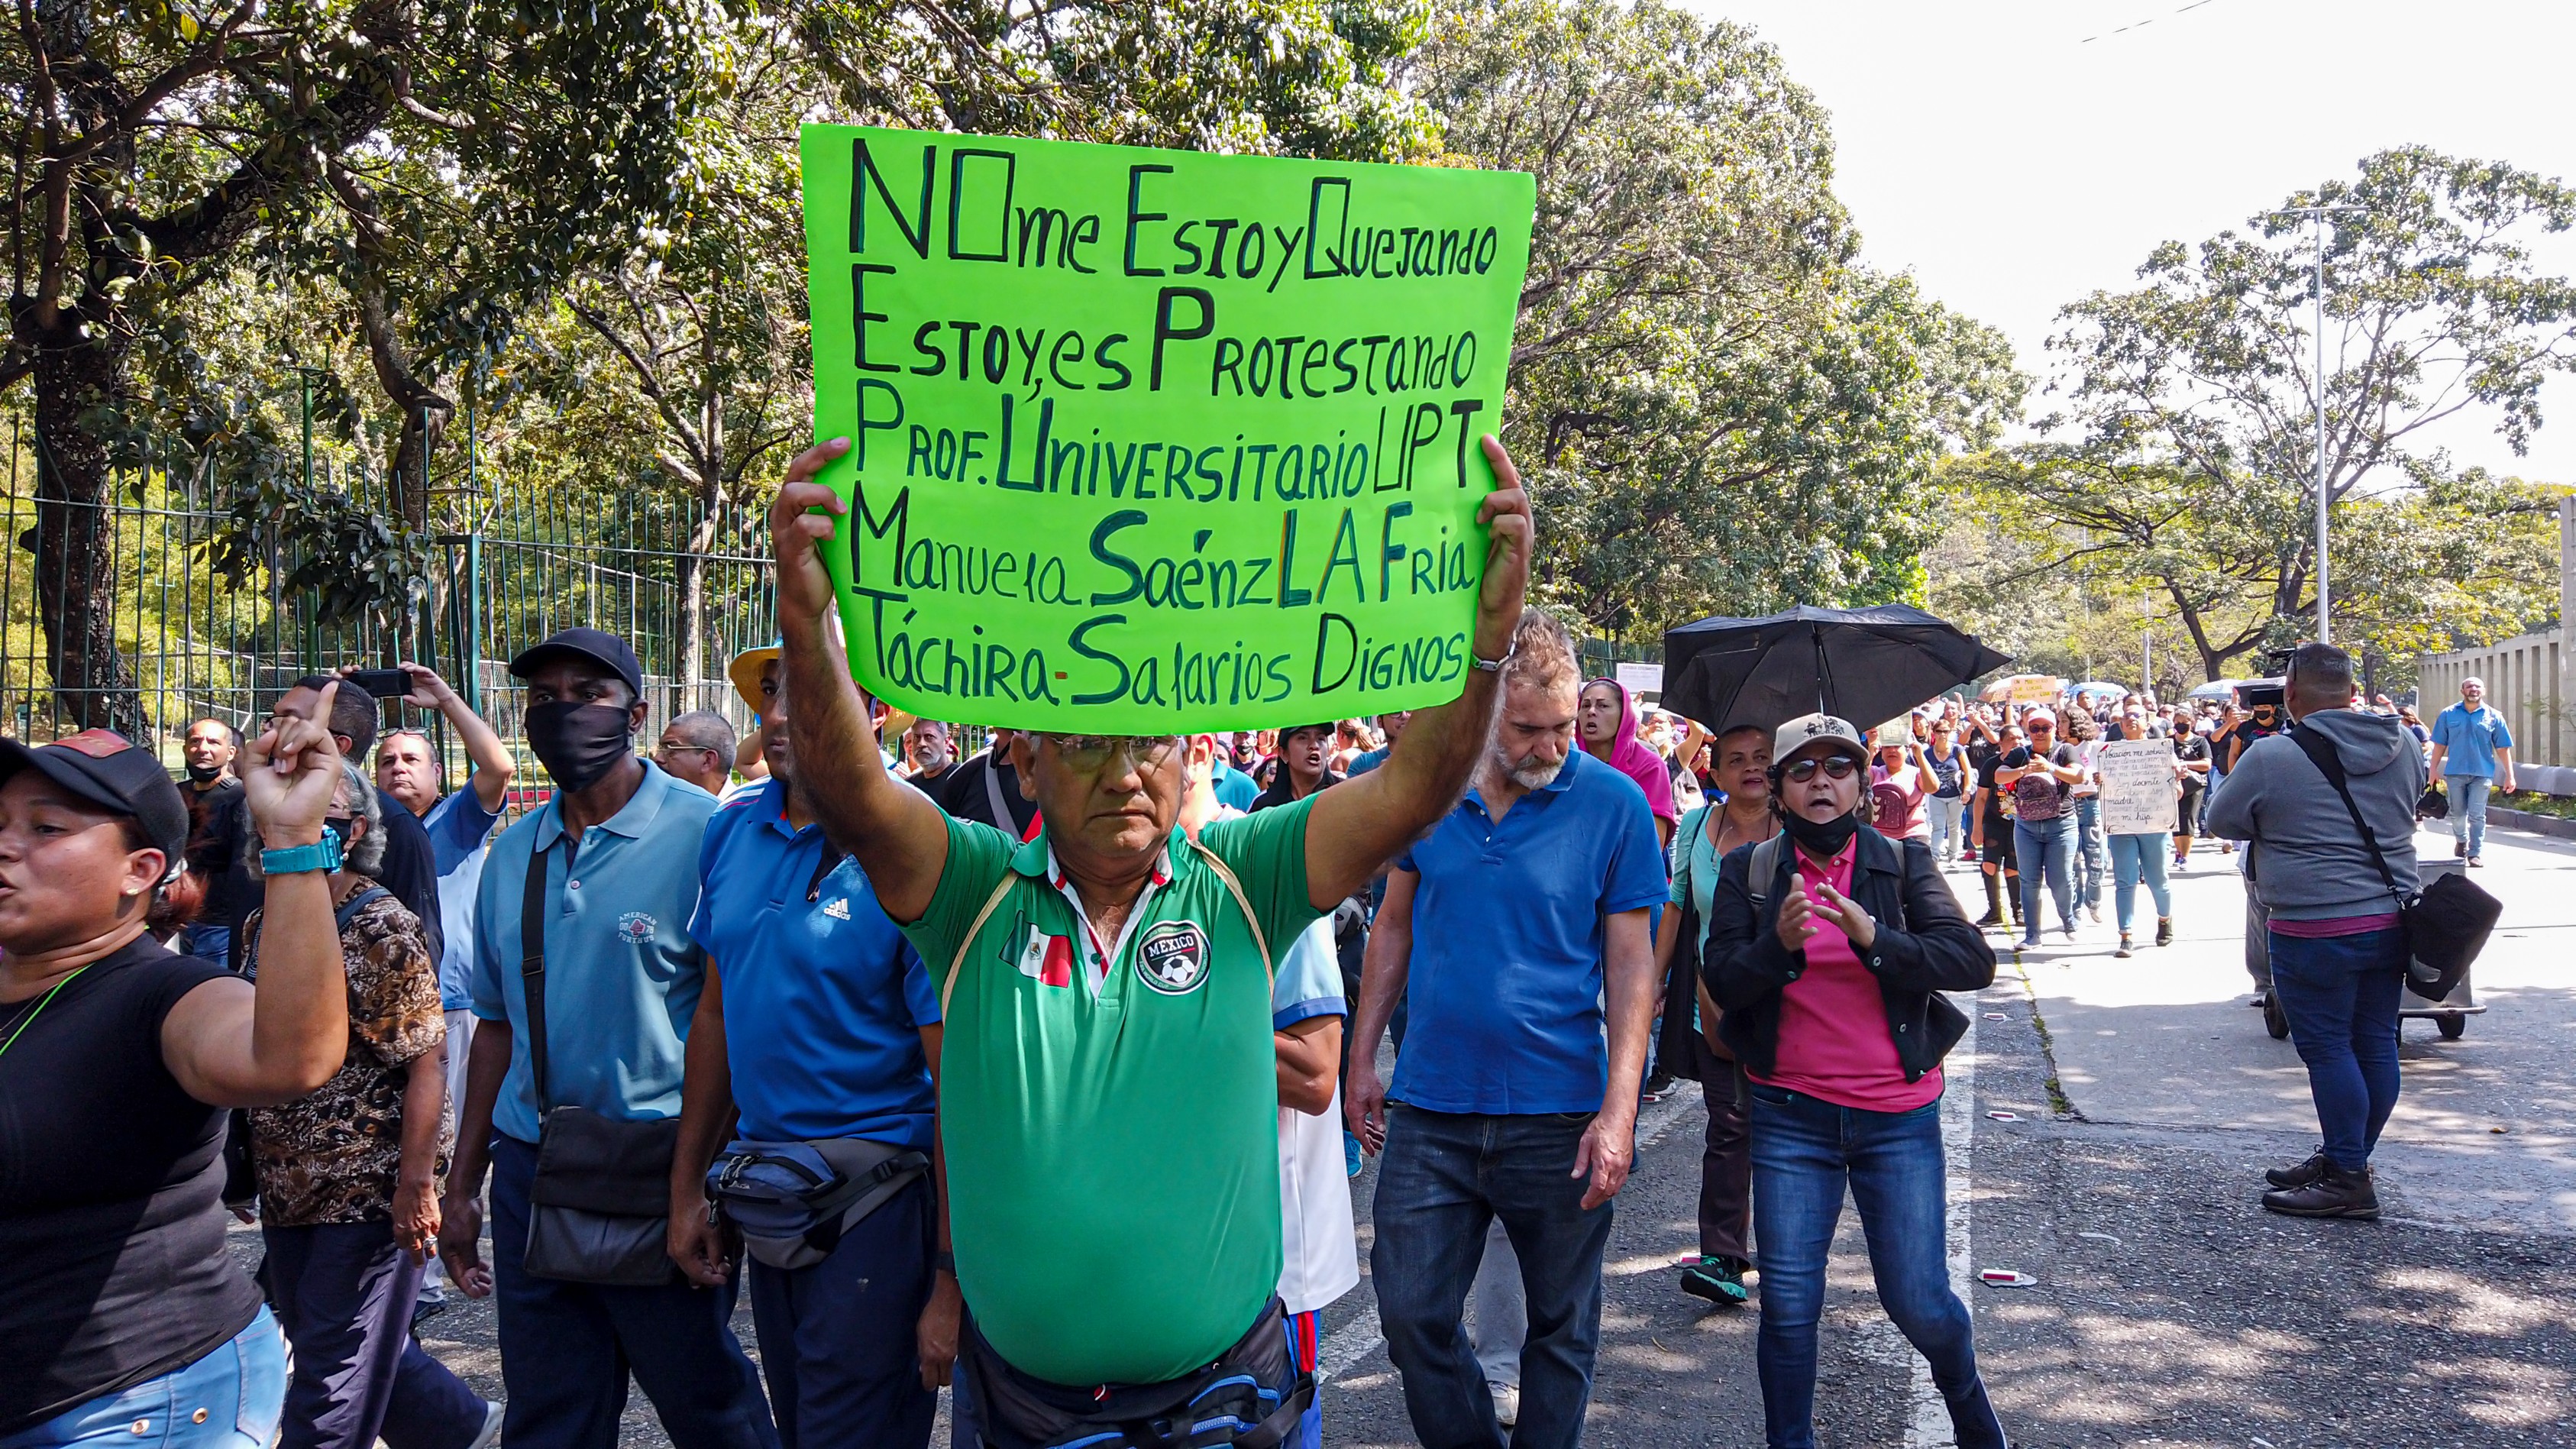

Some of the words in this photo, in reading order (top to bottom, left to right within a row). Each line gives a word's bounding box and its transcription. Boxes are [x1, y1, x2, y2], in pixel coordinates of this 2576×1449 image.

[849, 137, 1016, 263] NO
[1374, 399, 1483, 493] UPT
[851, 480, 1081, 605] Manuela
[1278, 508, 1366, 609] LA
[2132, 777, 2161, 786] docente
[2107, 796, 2135, 805] madre
[619, 911, 658, 925] AMERICAN
[824, 907, 852, 920] adidas
[1148, 935, 1194, 958] MEXICO
